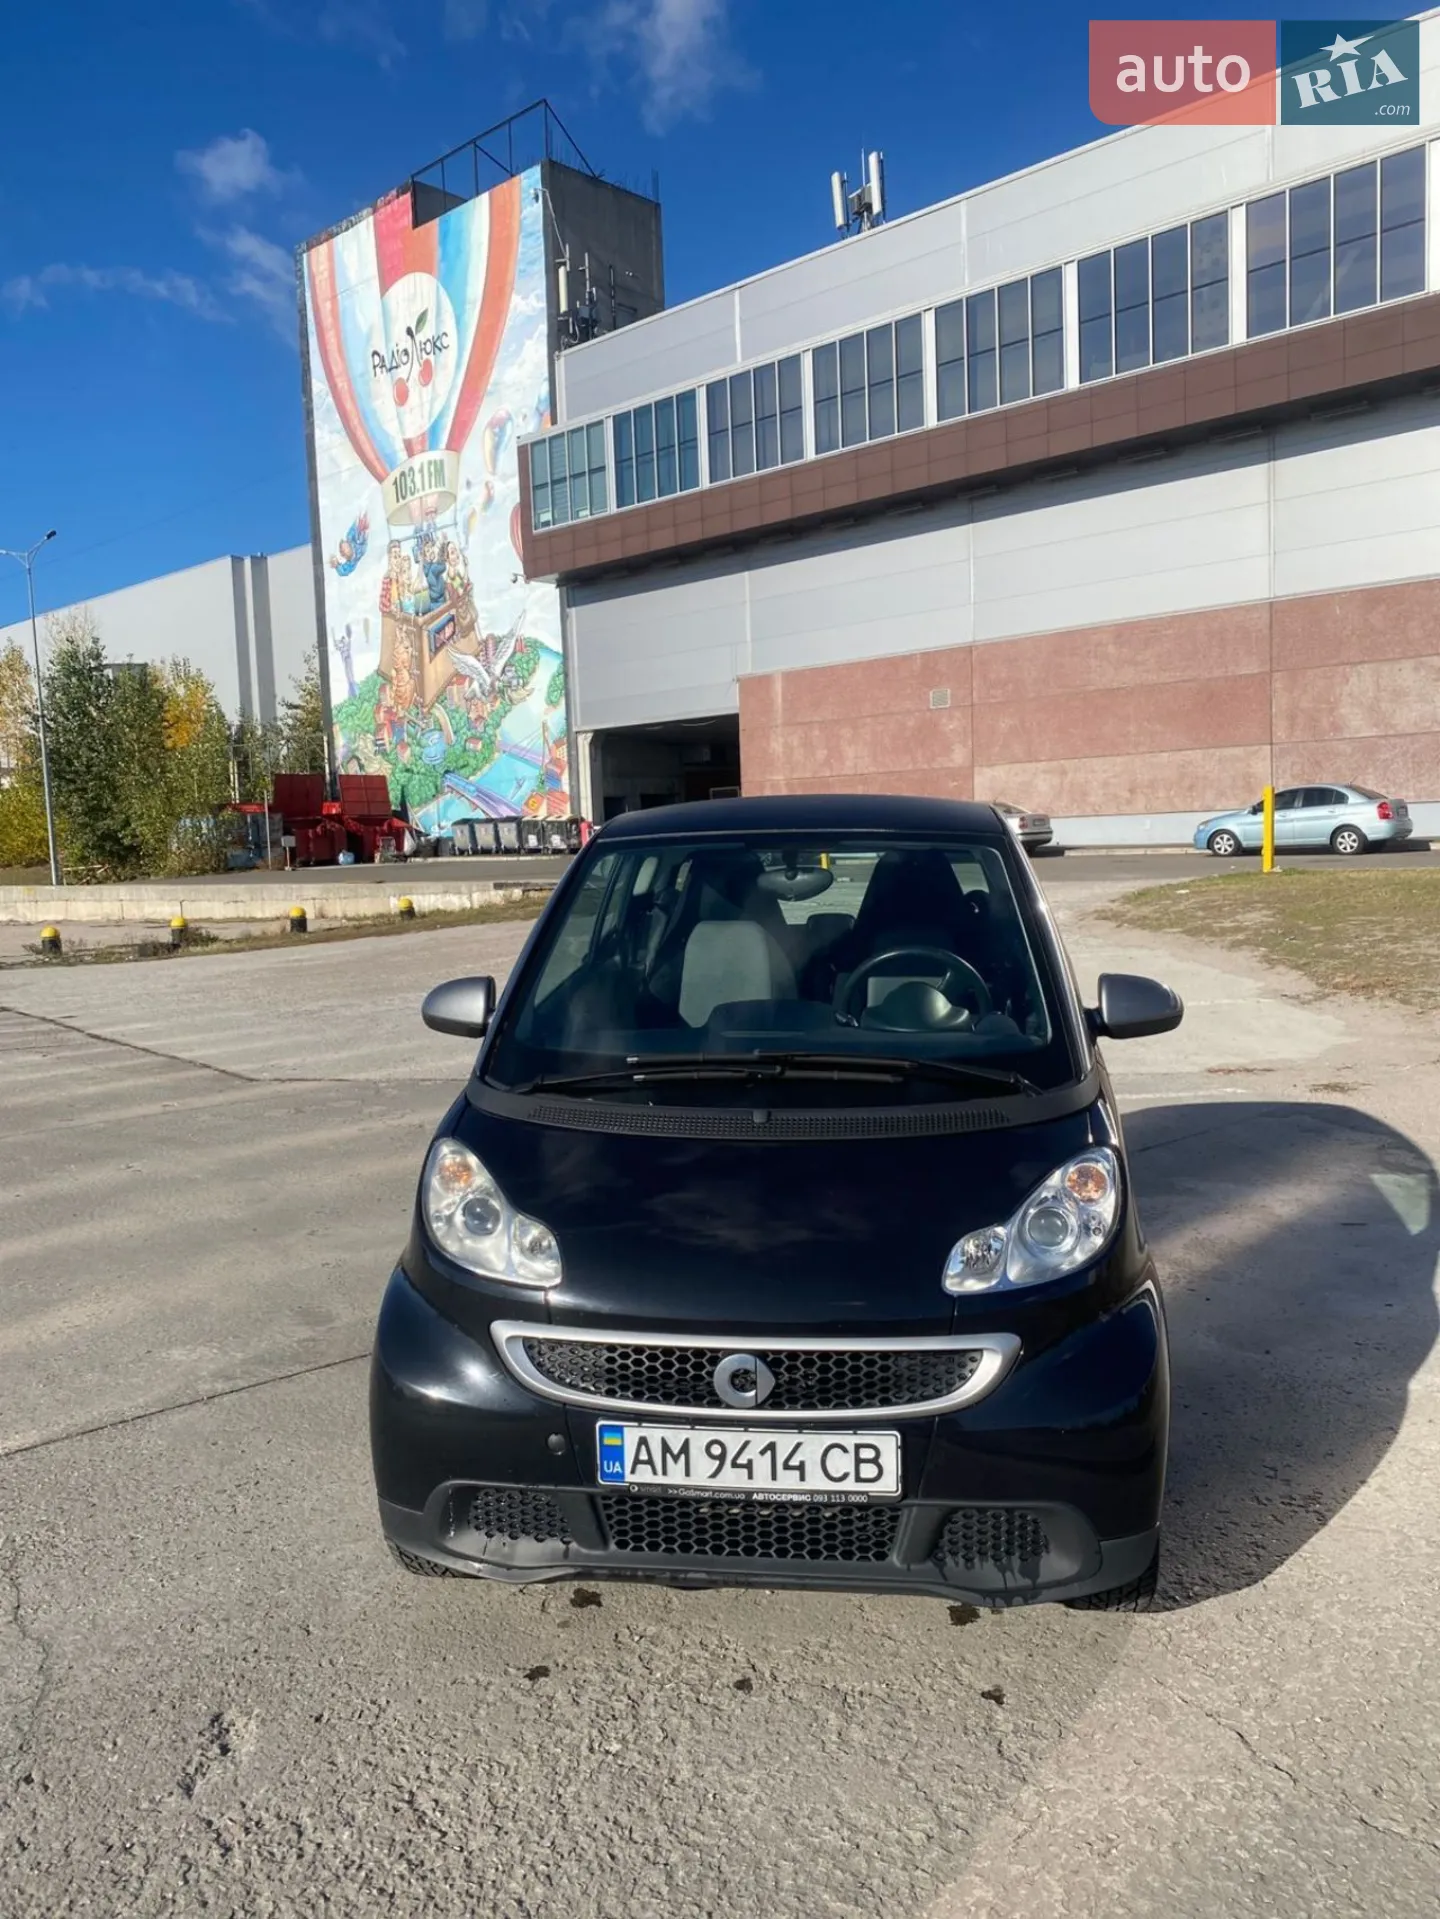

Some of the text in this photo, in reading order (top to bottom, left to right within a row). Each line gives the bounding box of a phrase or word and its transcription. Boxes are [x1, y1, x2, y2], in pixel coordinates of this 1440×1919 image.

[392, 458, 446, 504] 103.1 FM
[603, 1460, 623, 1473] UA
[630, 1435, 884, 1484] AM 9414 CB
[847, 1494, 869, 1503] 0000
